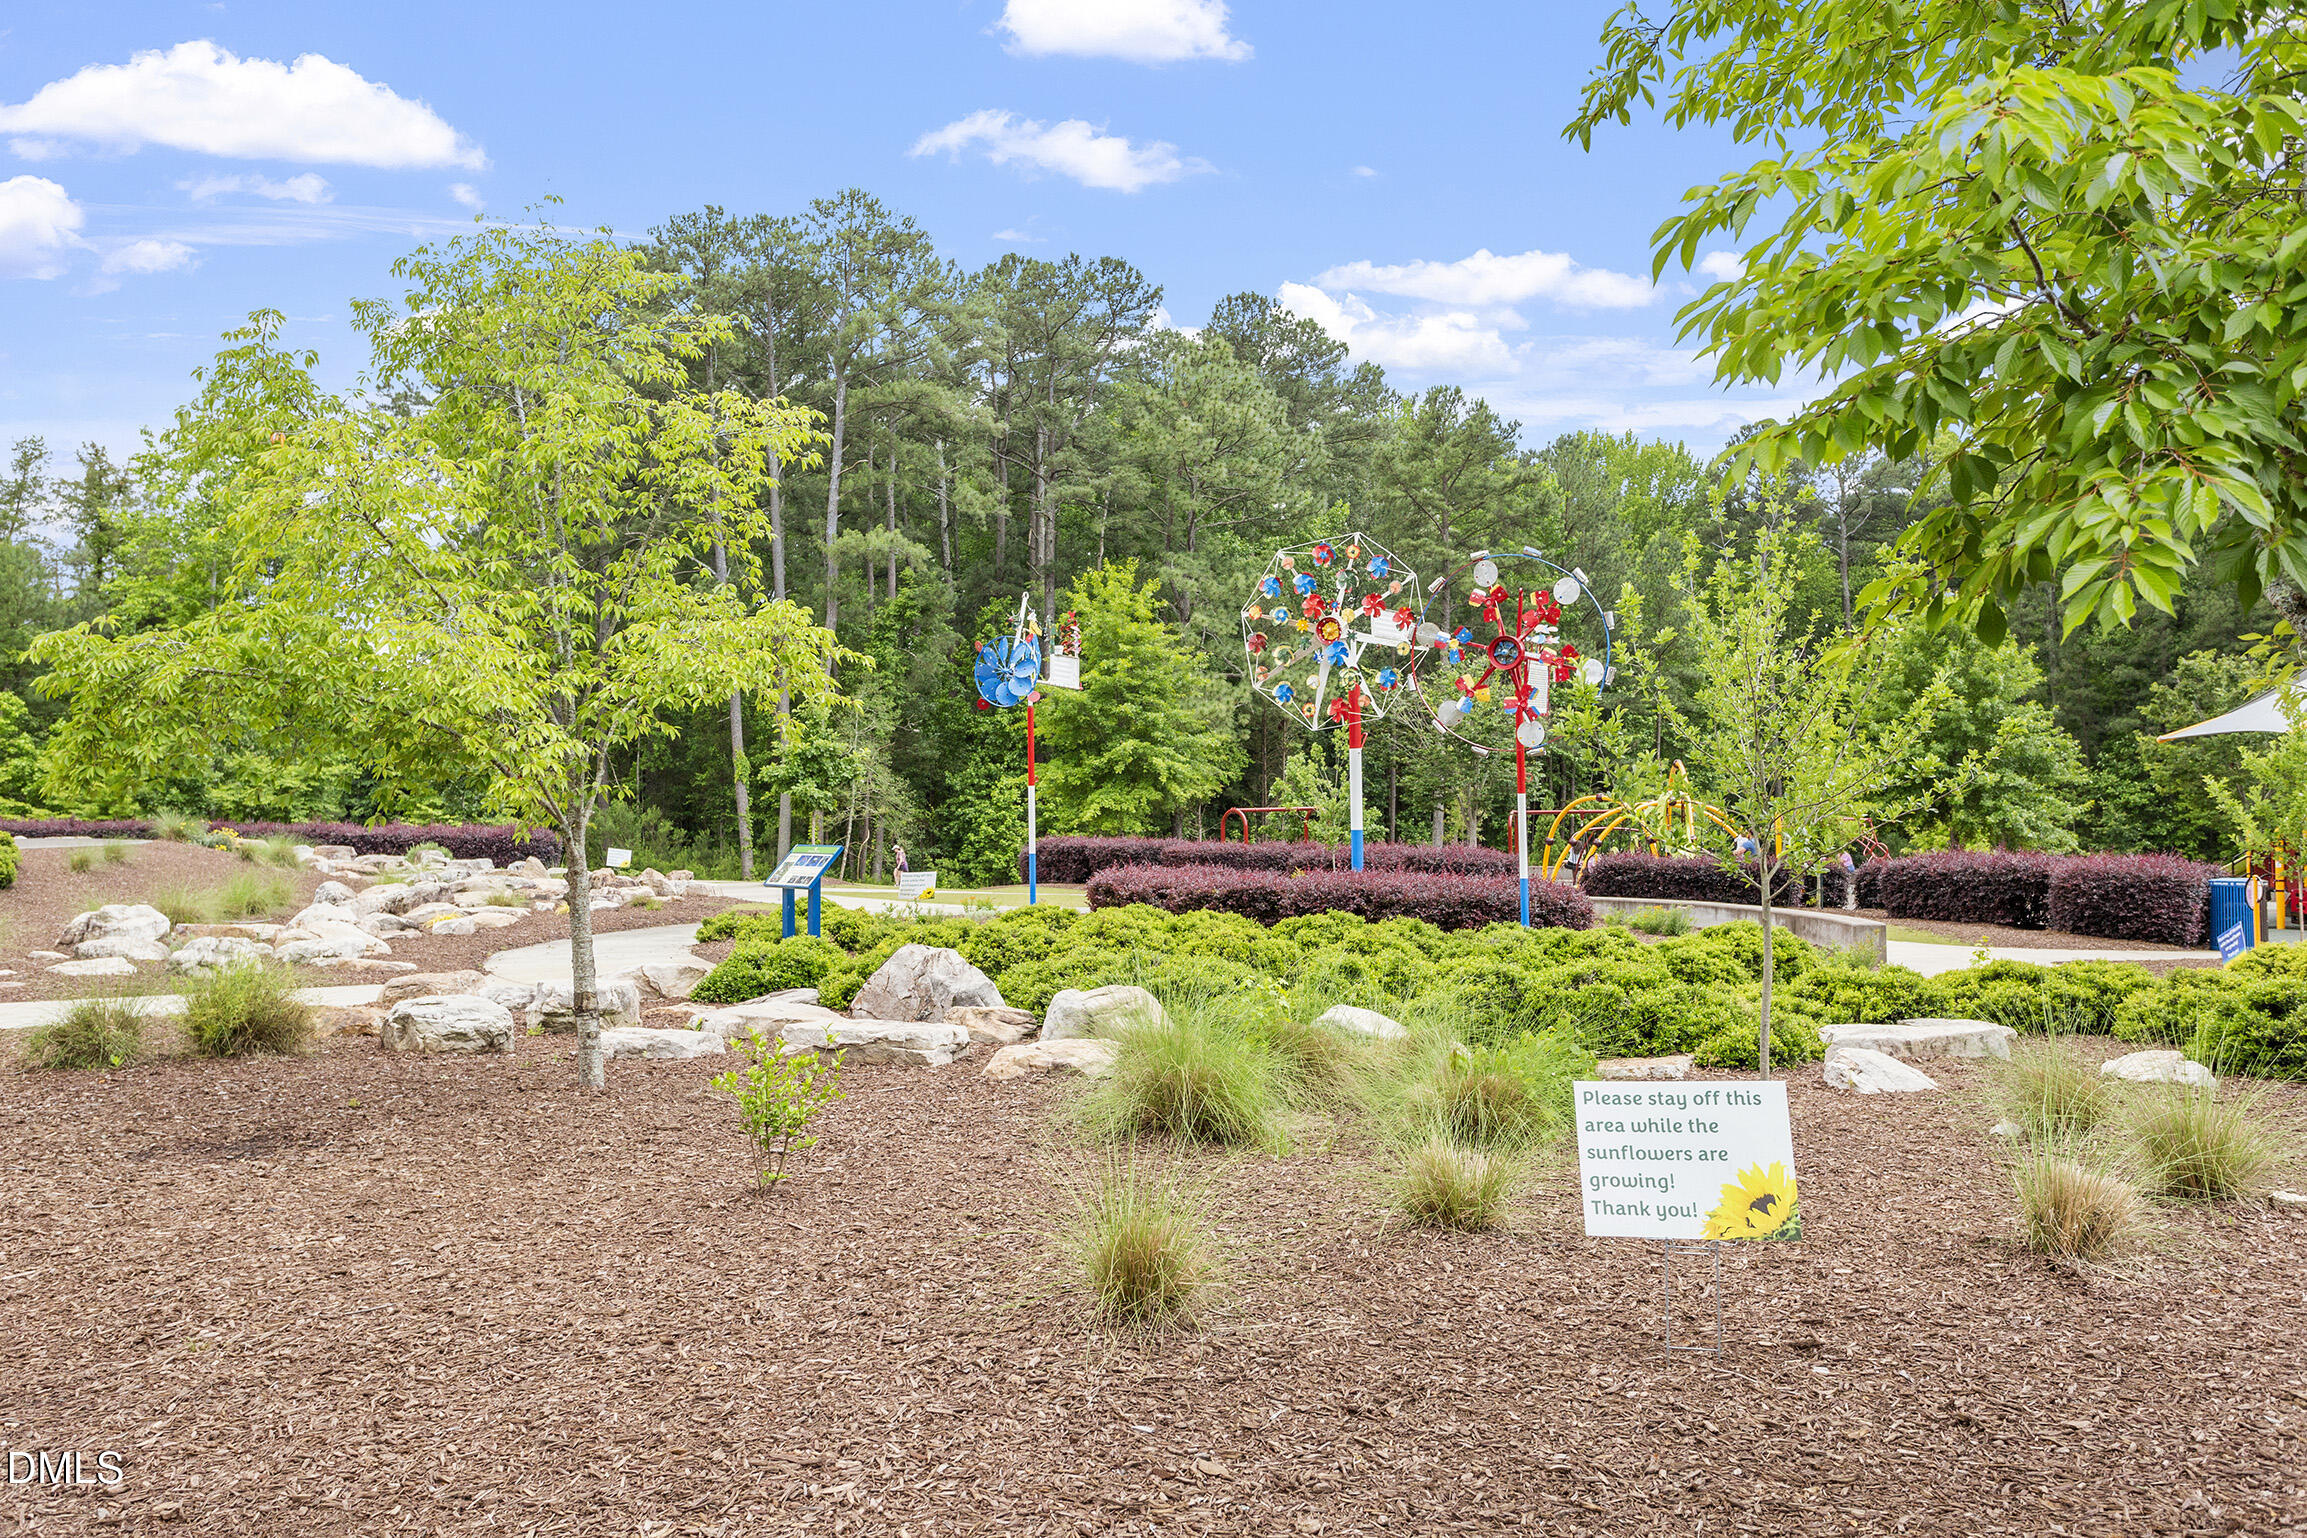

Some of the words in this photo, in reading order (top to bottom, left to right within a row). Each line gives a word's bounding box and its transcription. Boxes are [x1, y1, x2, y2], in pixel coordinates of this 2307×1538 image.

[1583, 1090, 1642, 1106] Please
[1648, 1091, 1687, 1110] stay
[1693, 1090, 1720, 1106] off
[1726, 1090, 1762, 1106] this
[1584, 1120, 1626, 1133] area
[1631, 1118, 1683, 1134] while
[1687, 1118, 1719, 1134] the
[1587, 1145, 1693, 1162] sunflowers
[1698, 1149, 1729, 1162] are
[1589, 1172, 1675, 1194] growing!
[1590, 1200, 1651, 1217] Thank
[1656, 1201, 1698, 1222] you!
